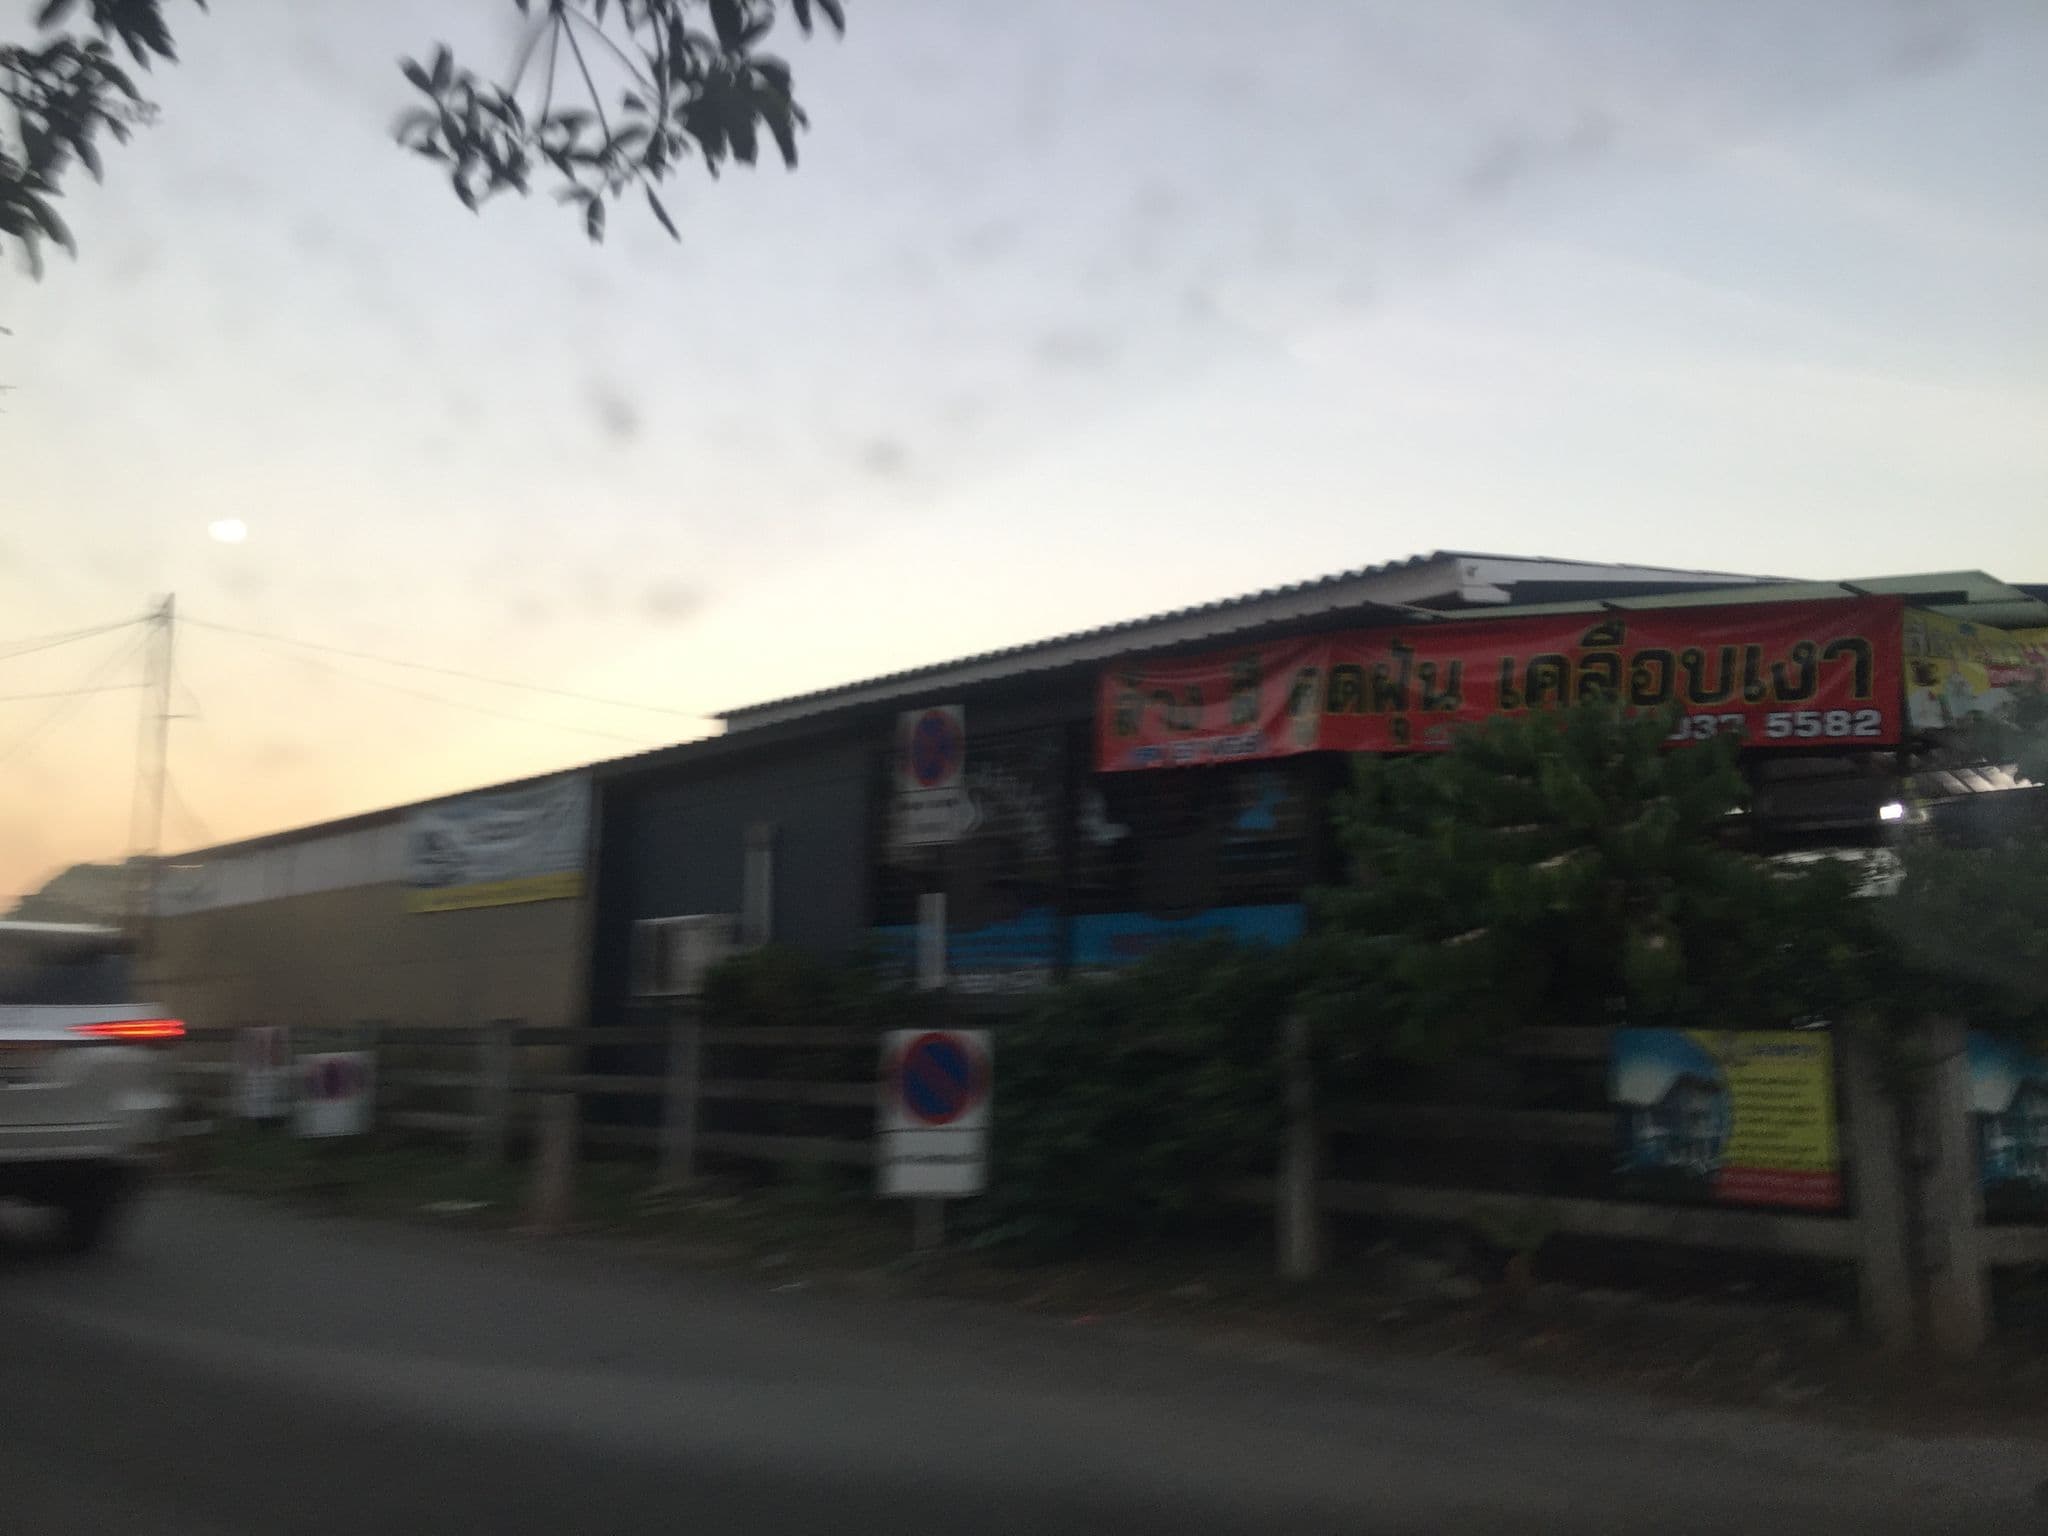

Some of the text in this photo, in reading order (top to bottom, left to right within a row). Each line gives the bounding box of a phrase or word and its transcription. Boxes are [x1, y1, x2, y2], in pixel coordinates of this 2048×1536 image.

[1499, 619, 1874, 708] เคลือบเงา
[1765, 710, 1881, 738] 5582
